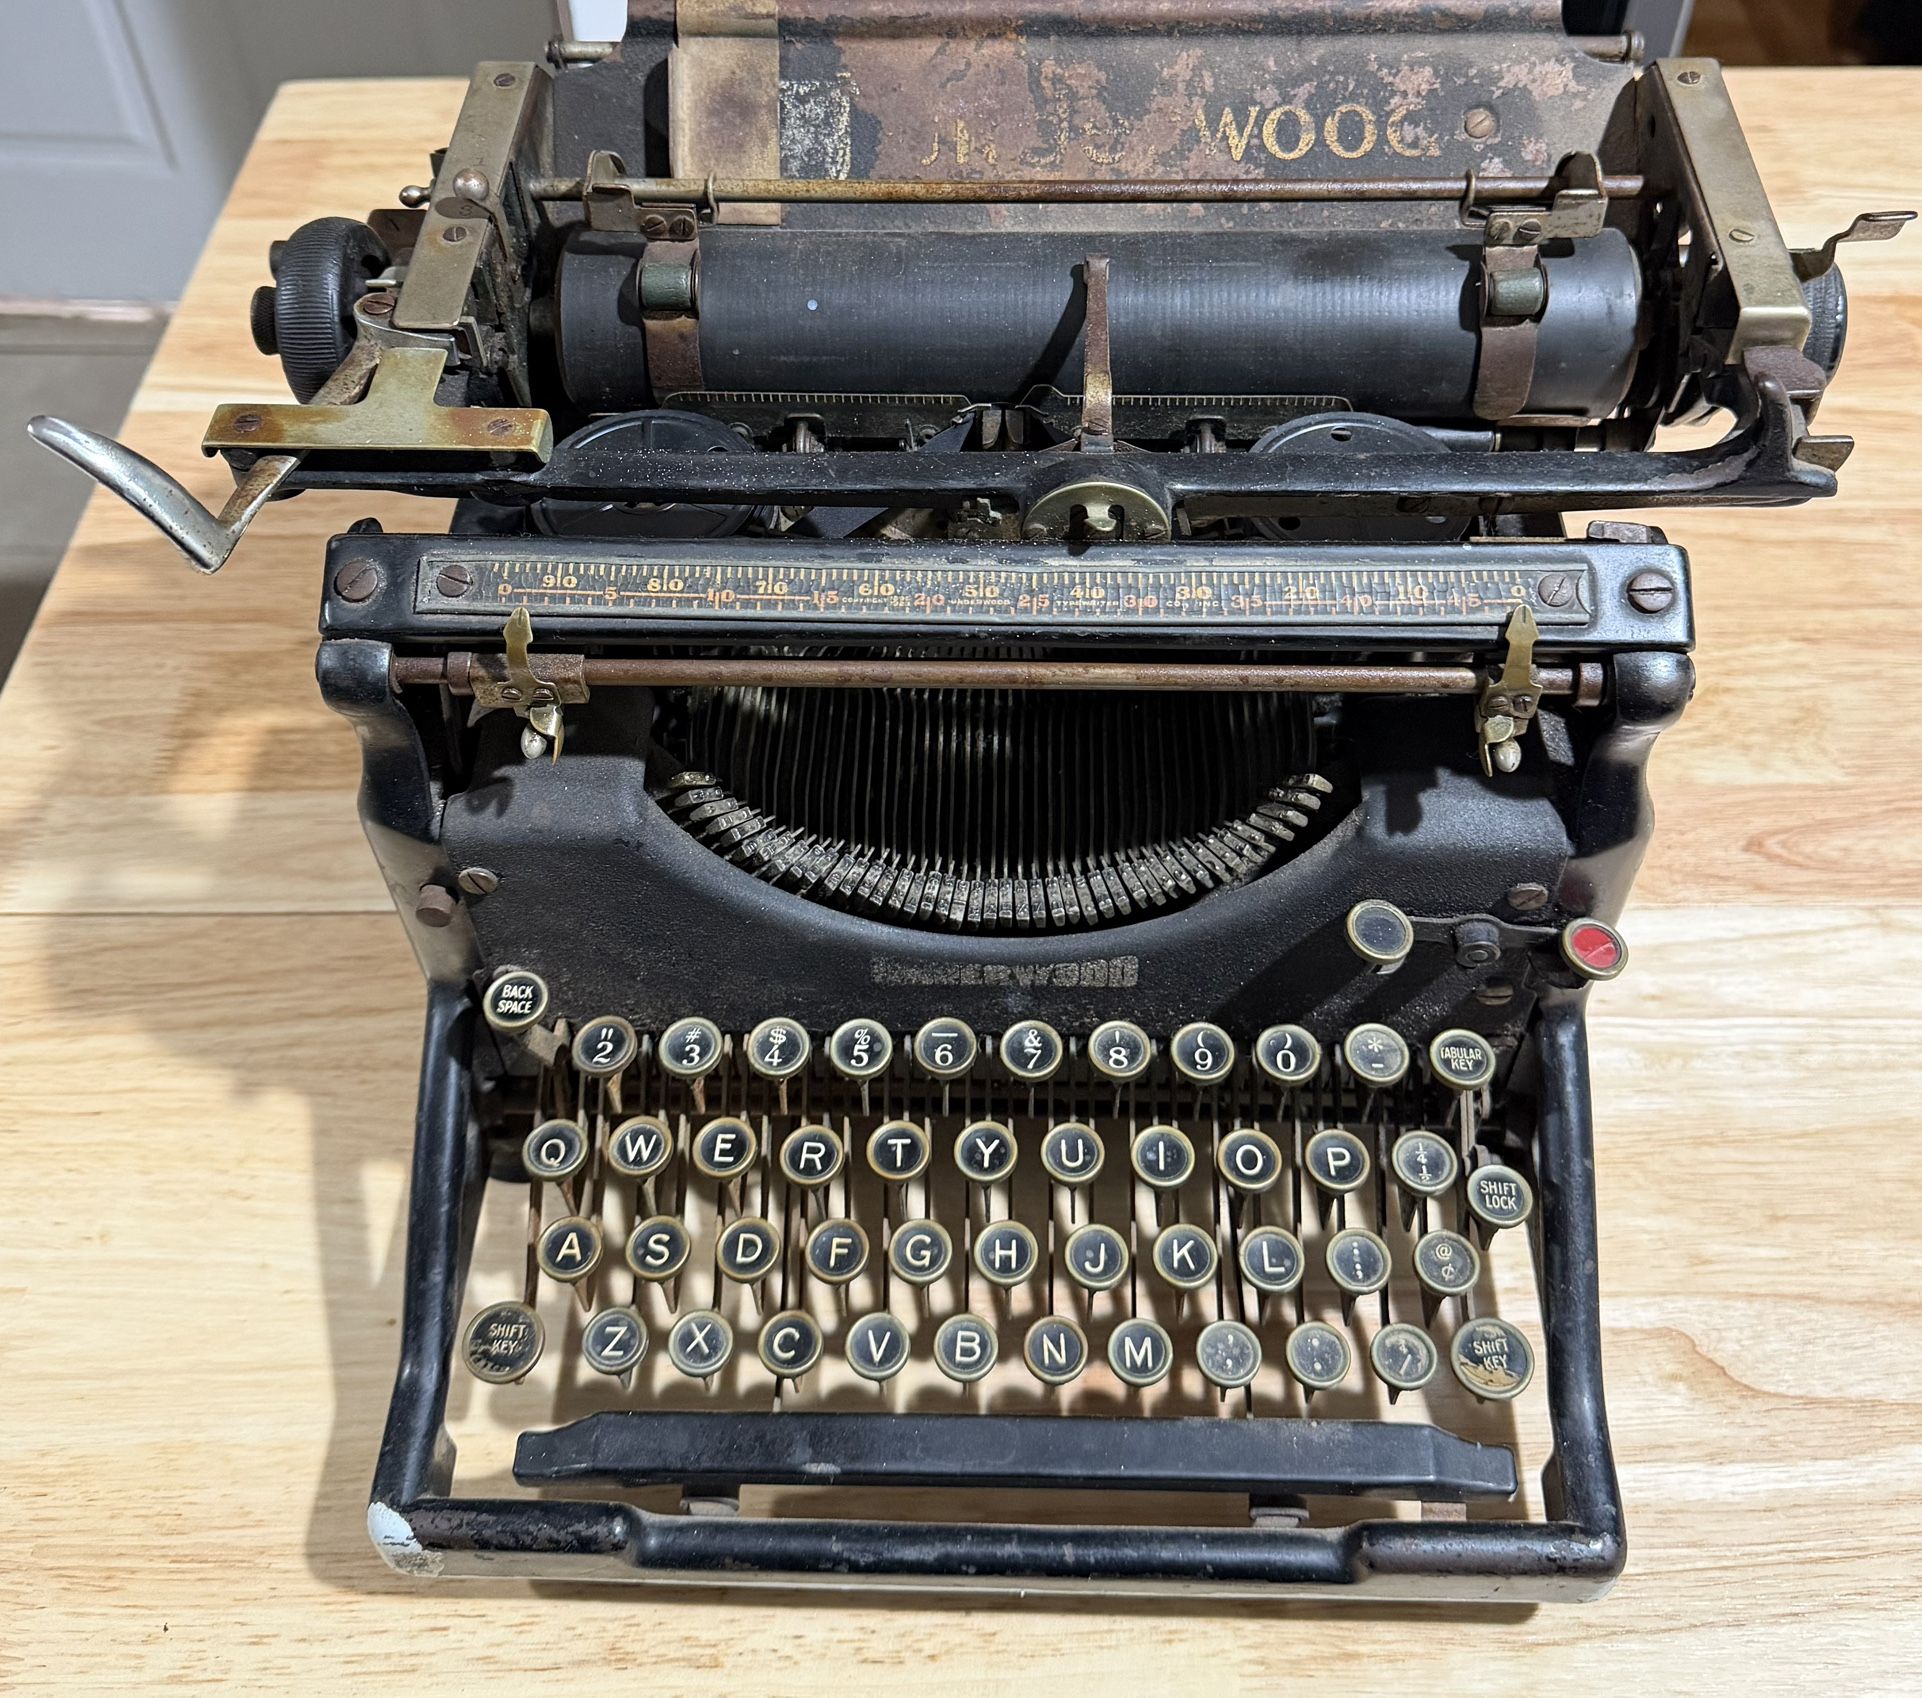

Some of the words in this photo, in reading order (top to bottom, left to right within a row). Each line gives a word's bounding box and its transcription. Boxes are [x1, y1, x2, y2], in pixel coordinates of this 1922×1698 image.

[498, 583, 512, 596] 0
[604, 586, 618, 600] 5
[706, 588, 736, 602] 10
[812, 590, 839, 604] 15
[1018, 594, 1050, 608] 25
[1124, 594, 1158, 608] 30
[1231, 594, 1263, 608] 35
[542, 574, 578, 588] 90
[647, 578, 684, 592] 80
[756, 580, 788, 594] 70
[858, 583, 895, 596] 60
[964, 584, 1000, 598] 50
[1070, 585, 1105, 599] 40
[1176, 586, 1212, 600] 30
[1510, 584, 1526, 597] 0
[869, 954, 1140, 988] ERWOOD
[501, 984, 534, 999] BACK
[496, 1000, 532, 1014] SPACE
[592, 1042, 614, 1064] 2
[682, 1044, 700, 1066] 3
[764, 1044, 783, 1066] 4
[850, 1044, 870, 1068] 5
[934, 1043, 954, 1066] 6
[1024, 1049, 1042, 1070] 7
[1108, 1046, 1128, 1069] 8
[1194, 1048, 1213, 1071] 9
[1440, 1046, 1482, 1061] TABULAR
[1450, 1058, 1474, 1071] KEY
[540, 1138, 566, 1168] Q
[624, 1133, 657, 1164] W
[712, 1133, 736, 1163] E
[799, 1141, 826, 1171] R
[887, 1138, 912, 1168] T
[975, 1138, 1000, 1168] Y
[1060, 1138, 1084, 1168] U
[1158, 1140, 1165, 1171] I
[1235, 1144, 1264, 1176] O
[1326, 1146, 1351, 1177] P
[1479, 1180, 1518, 1196] SHIFT
[1485, 1194, 1518, 1210] LOCK
[554, 1232, 582, 1264] A
[644, 1233, 671, 1266] S
[735, 1232, 764, 1265] D
[829, 1236, 853, 1269] F
[905, 1234, 932, 1268] G
[994, 1238, 1017, 1270] H
[1084, 1242, 1106, 1274] J
[1172, 1238, 1196, 1271] K
[1262, 1240, 1286, 1274] L
[488, 1323, 526, 1339] SHIFT
[600, 1326, 628, 1357] Z
[685, 1322, 712, 1354] X
[772, 1326, 800, 1360] C
[490, 1340, 518, 1356] KEY
[868, 1329, 891, 1364] V
[954, 1330, 982, 1364] B
[1042, 1332, 1066, 1367] N
[1124, 1336, 1152, 1369] M
[1473, 1338, 1509, 1358] SHIFT
[1483, 1354, 1508, 1370] KEY
